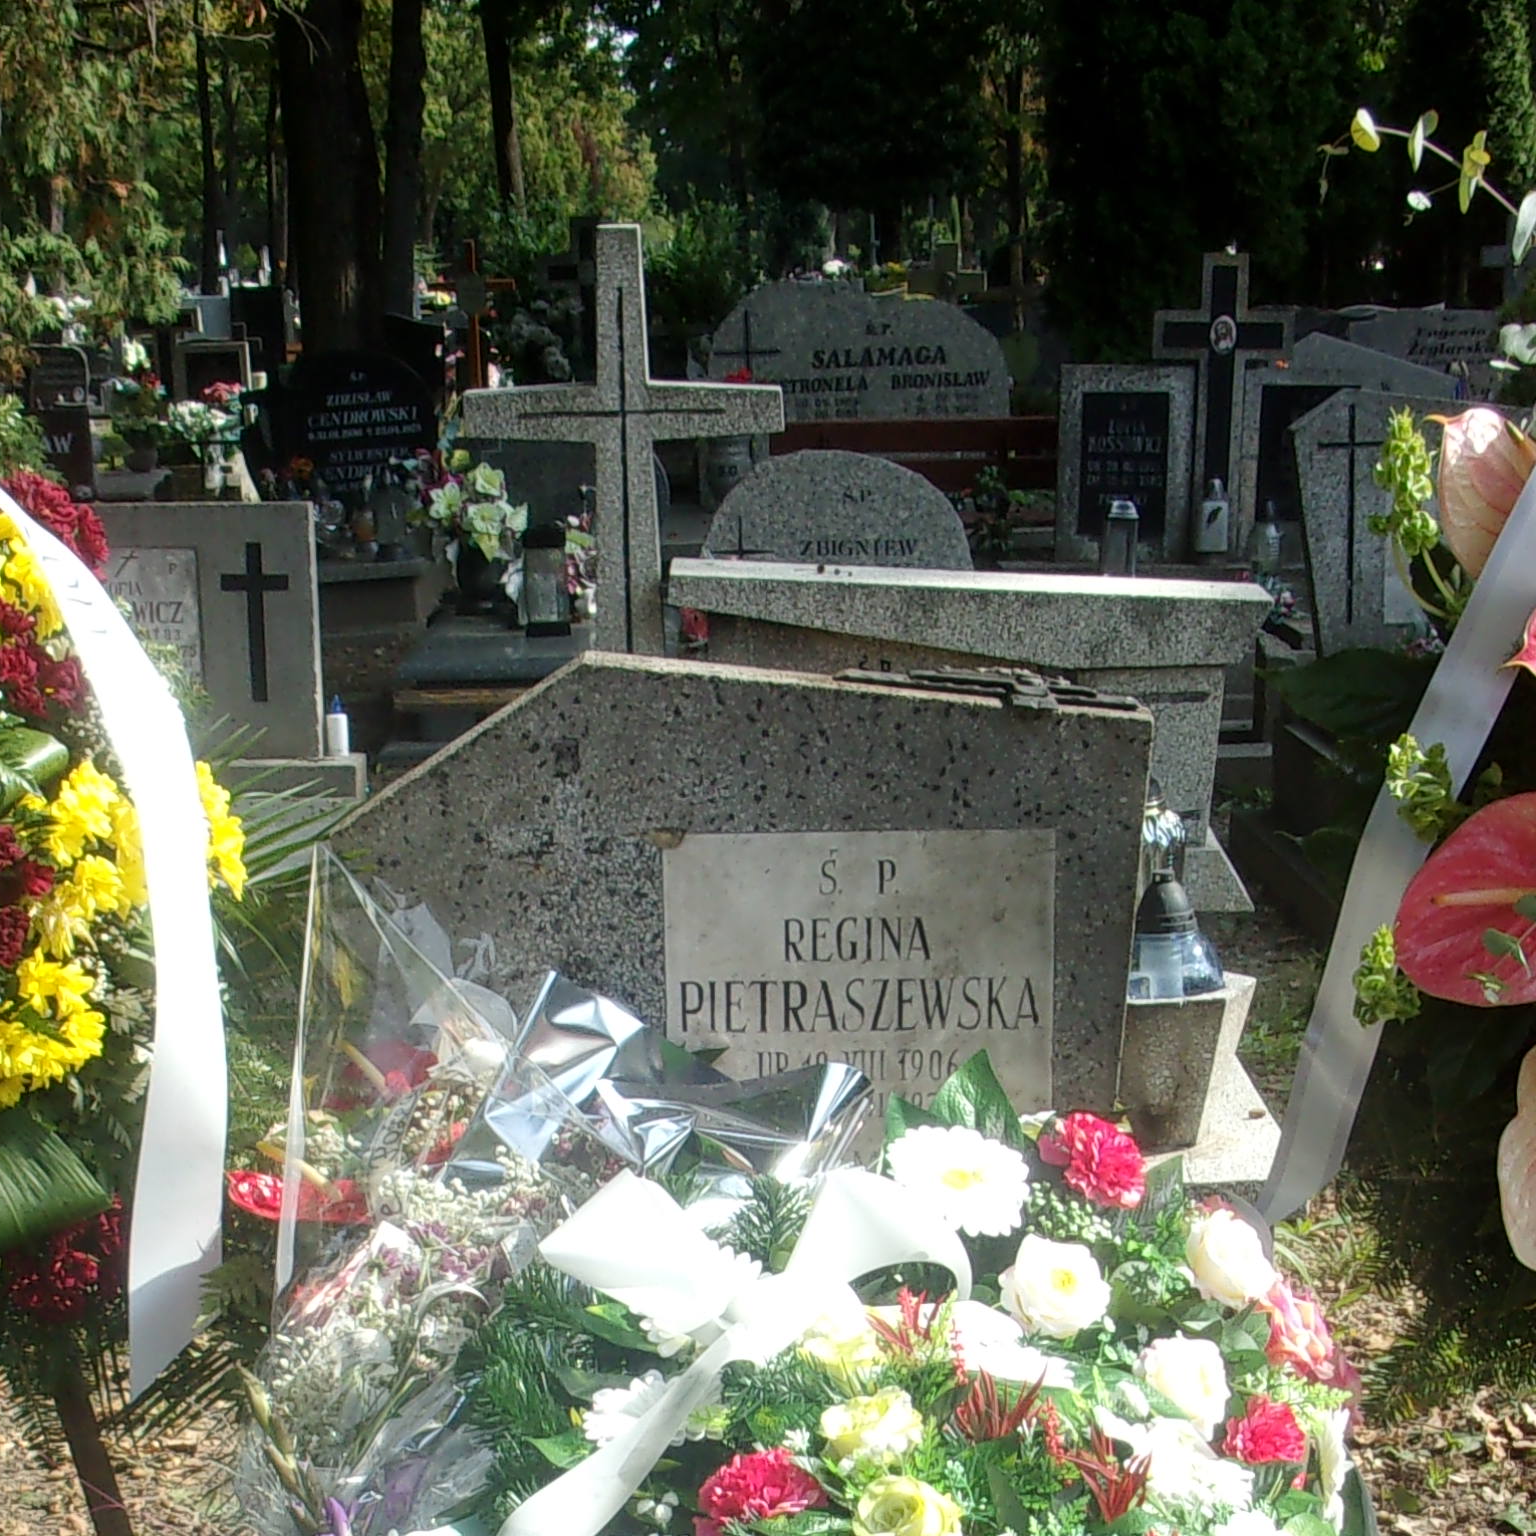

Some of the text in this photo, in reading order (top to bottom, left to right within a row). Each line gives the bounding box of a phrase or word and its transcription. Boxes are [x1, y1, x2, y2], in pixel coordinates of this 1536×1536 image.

[782, 373, 868, 394] ETRONELA
[800, 538, 918, 557] ZBIGNIEW
[783, 916, 932, 964] REGINA
[679, 976, 1042, 1033] PIETRASZEWSKA
